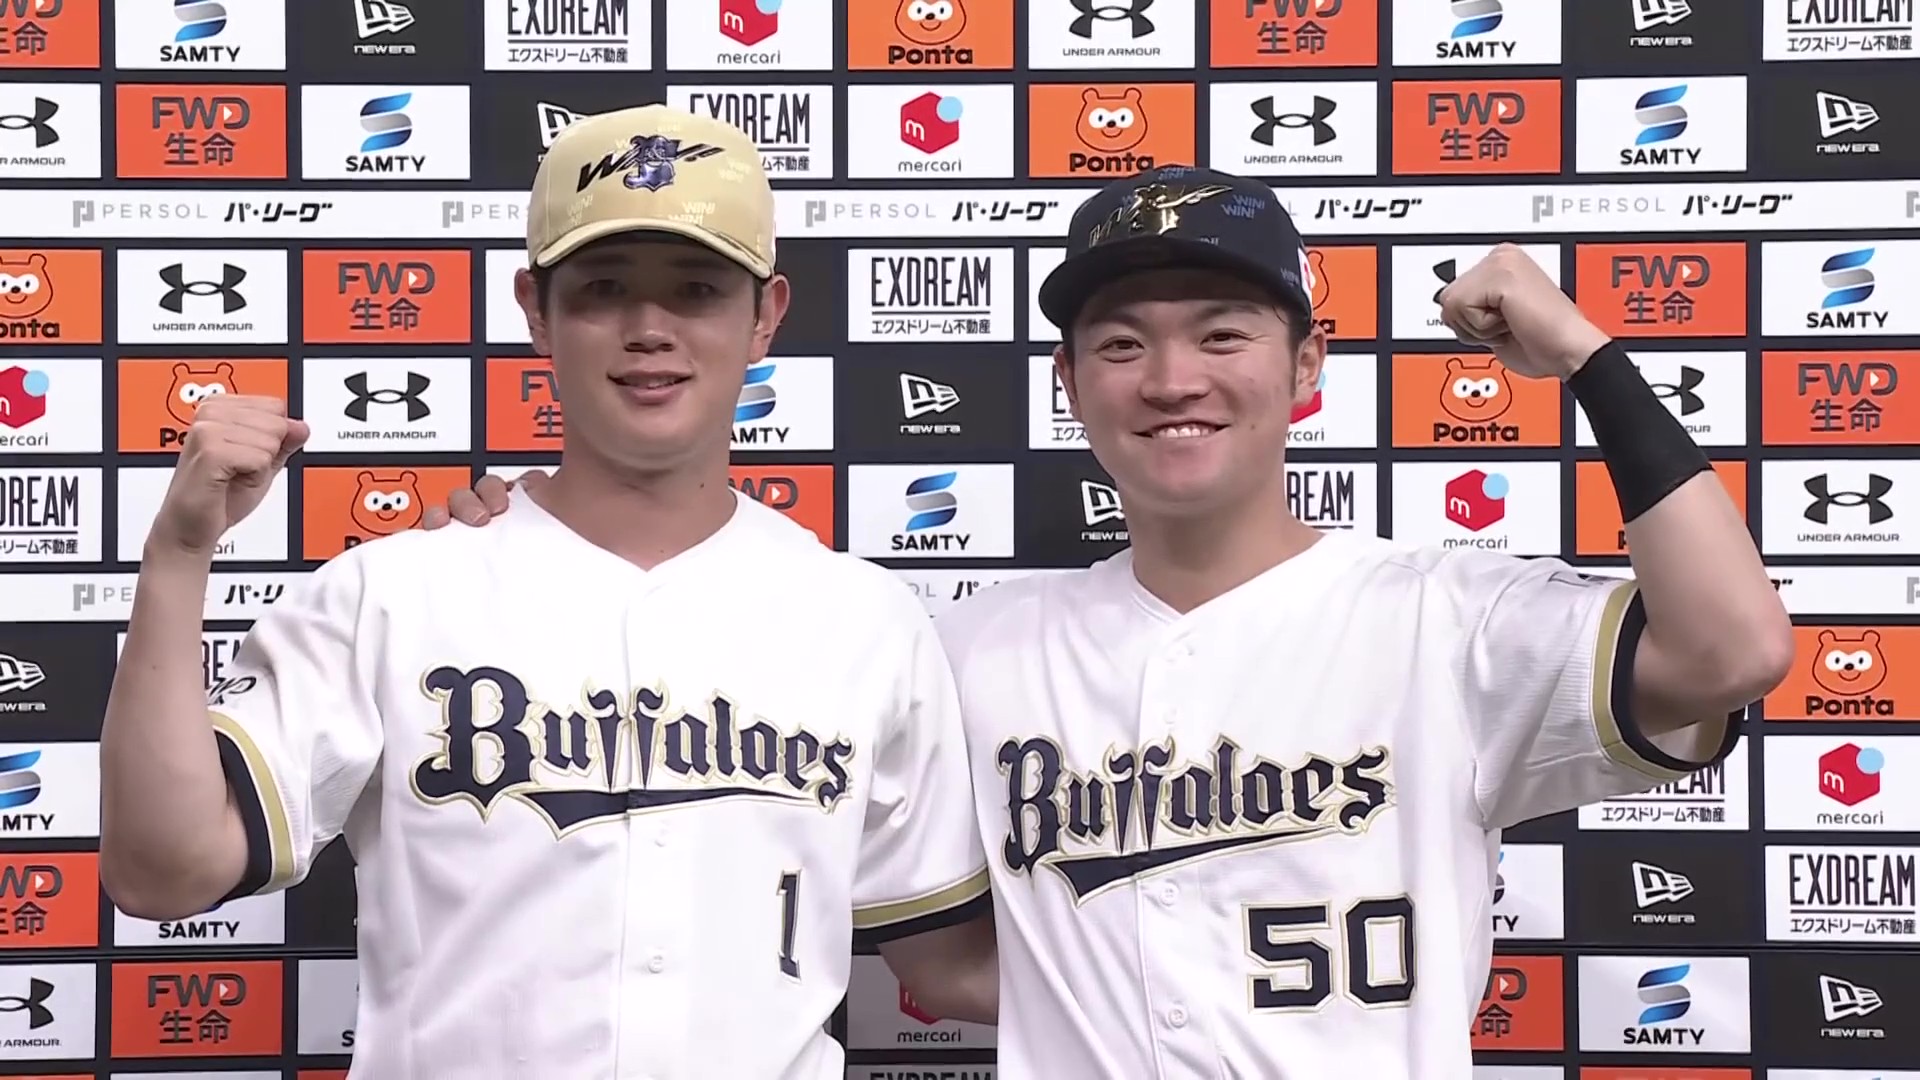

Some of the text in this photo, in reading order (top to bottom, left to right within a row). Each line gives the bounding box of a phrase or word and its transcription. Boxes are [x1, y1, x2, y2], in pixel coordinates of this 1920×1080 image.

[507, 0, 628, 35] EXDREAM
[1257, 21, 1328, 55] 生命
[1786, 35, 1914, 52] エクスドリーム不動産
[159, 45, 241, 63] SAMTY
[507, 47, 628, 63] エクスドリーム不動産
[717, 48, 781, 64] mercari
[888, 45, 973, 65] Ponta
[1062, 47, 1161, 57] UNDER ARMOUR
[1436, 41, 1517, 58] SAMTY
[151, 96, 251, 130] FWD
[1427, 92, 1526, 126] FWD
[164, 132, 236, 167] 生命
[1440, 128, 1512, 162] 生命
[10, 157, 66, 166] ARMOUR
[345, 155, 426, 173] SAMTY
[898, 158, 962, 173] mercari
[1069, 152, 1154, 172] Ponta
[1244, 154, 1343, 164] UNDER ARMOUR
[1619, 148, 1702, 166] SAMTY
[833, 203, 937, 219] PERSOL
[1233, 194, 1265, 210] WIN!
[1561, 197, 1666, 213] PERSOL
[102, 204, 208, 219] PERSOL
[470, 205, 527, 220] PER
[1221, 204, 1255, 220] WIN!
[337, 262, 436, 295] FWD
[871, 256, 991, 306] EXDREAM
[1611, 255, 1710, 289] FWD
[349, 297, 421, 331] 生命
[1623, 291, 1695, 325] 生命
[153, 323, 254, 331] UNDER ARMOUR
[871, 319, 991, 335] エクスドリーム不動産
[1806, 311, 1889, 329] SAMTY
[1797, 363, 1897, 396] FWD
[533, 405, 563, 438] 生
[1810, 399, 1883, 432] 生命
[337, 431, 438, 440] UNDER ARMOUR
[730, 426, 790, 443] MTY
[1287, 427, 1325, 442] rcari
[1433, 422, 1519, 442] Ponta
[1685, 424, 1711, 433] OUR
[1286, 470, 1354, 521] REAM
[890, 533, 970, 551] SAMTY
[1797, 532, 1900, 542] UNDER ARMOUR
[224, 584, 285, 604] パ・リ
[1805, 695, 1894, 715] Ponta
[409, 664, 856, 825] Buffaloes
[995, 733, 1399, 878] Buffaloes
[1601, 806, 1726, 823] エクスドリーム不動産
[0, 814, 55, 831] MTY
[1816, 810, 1884, 825] mercari
[1789, 853, 1916, 907] EXDREAM
[158, 920, 241, 939] SAMTY
[777, 868, 803, 984] 1
[1790, 918, 1917, 934] エクスドリーム不動産
[1243, 892, 1417, 1015] 50
[147, 973, 247, 1008] FWD
[159, 1010, 232, 1045] 生命
[1471, 1003, 1513, 1038] 命
[3, 1038, 61, 1048] ARMOUR
[897, 1028, 961, 1043] mercari
[1622, 1028, 1705, 1046] SAMTY
